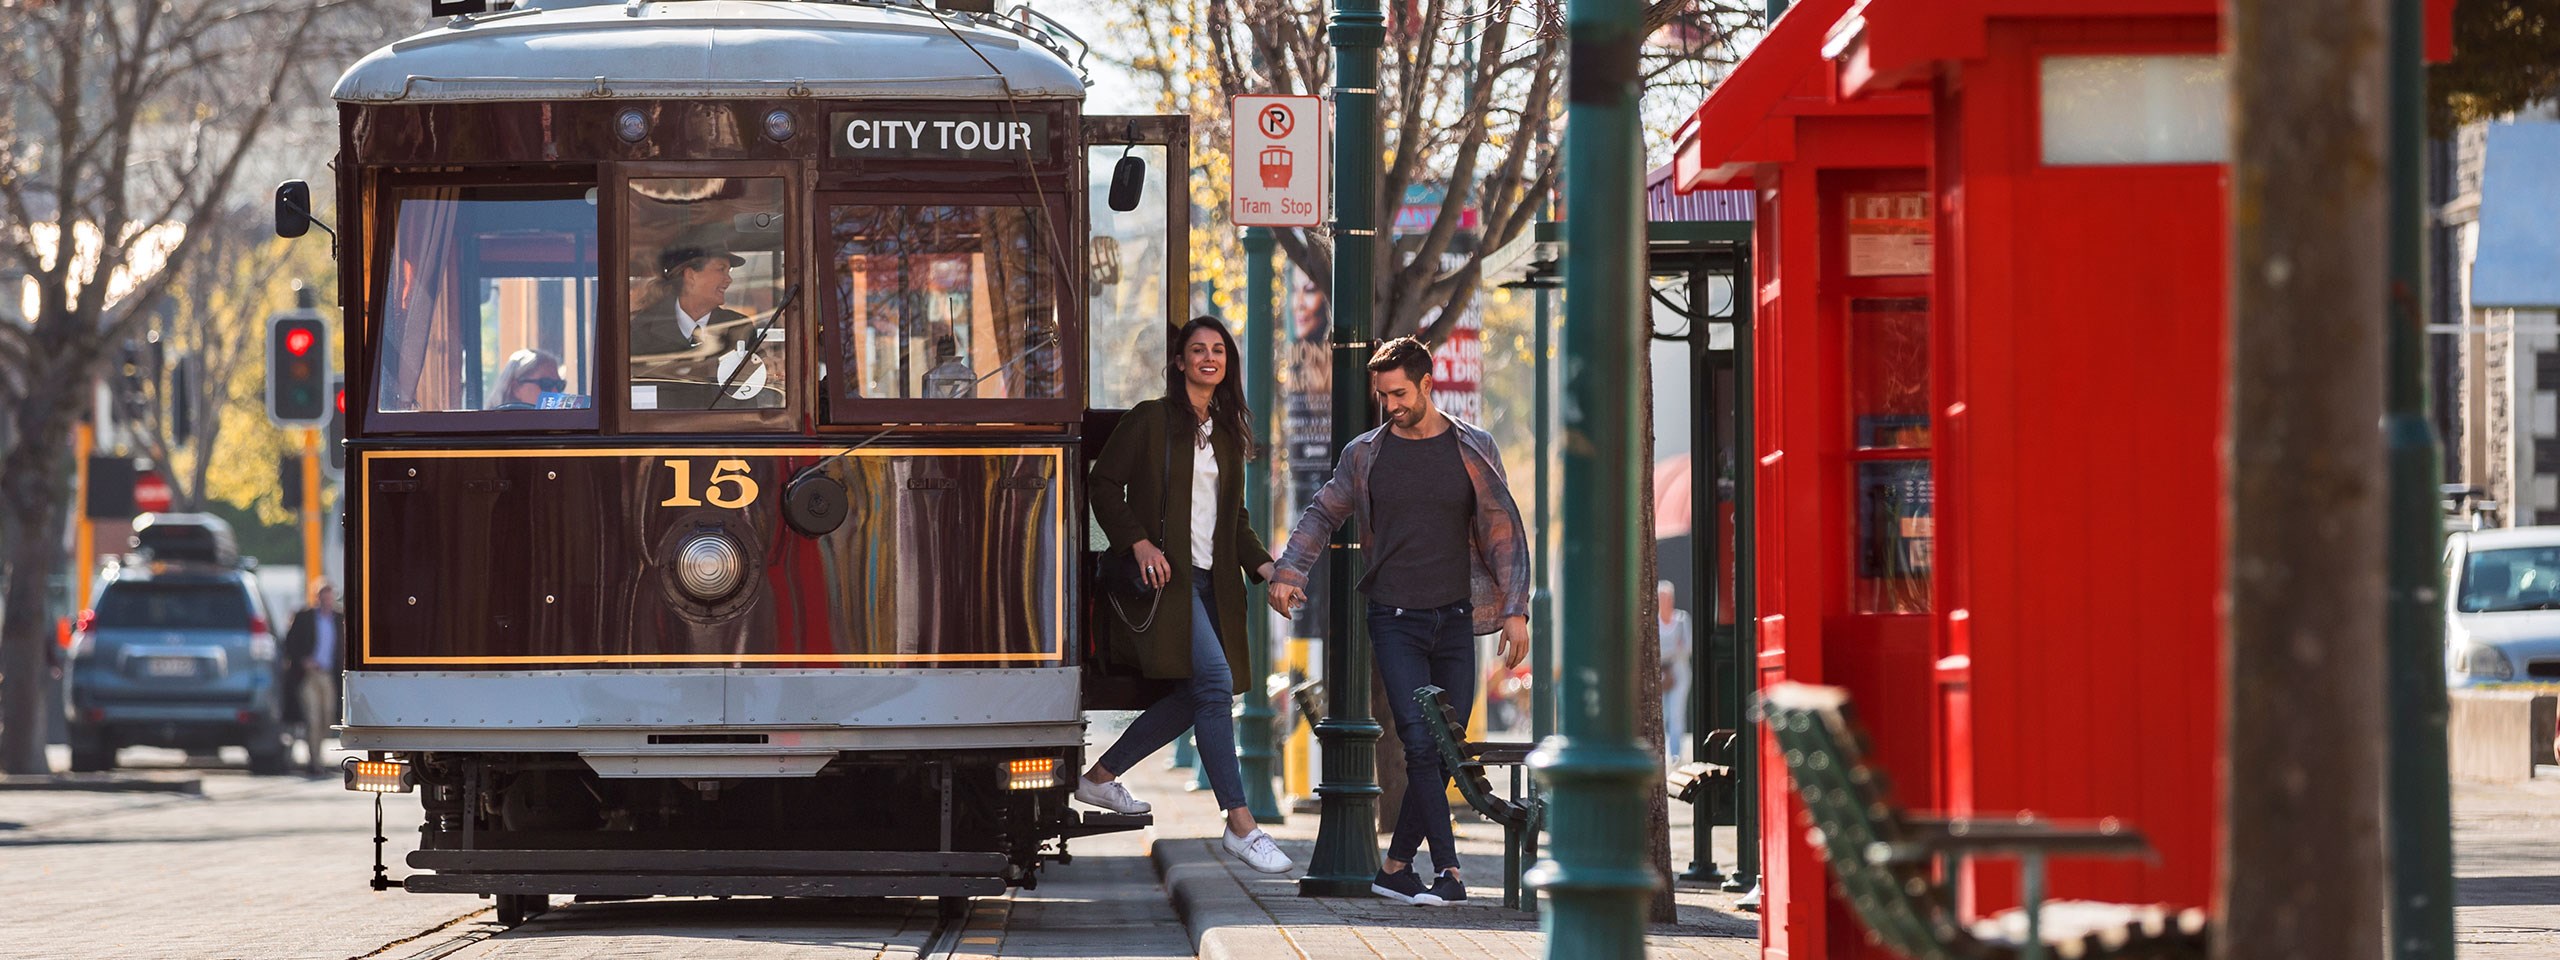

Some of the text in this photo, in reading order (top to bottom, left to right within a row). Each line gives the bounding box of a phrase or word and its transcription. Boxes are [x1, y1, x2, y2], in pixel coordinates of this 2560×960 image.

[847, 120, 1031, 150] CITY TOUR
[1240, 197, 1313, 217] Tram Stop
[661, 459, 759, 509] 15
